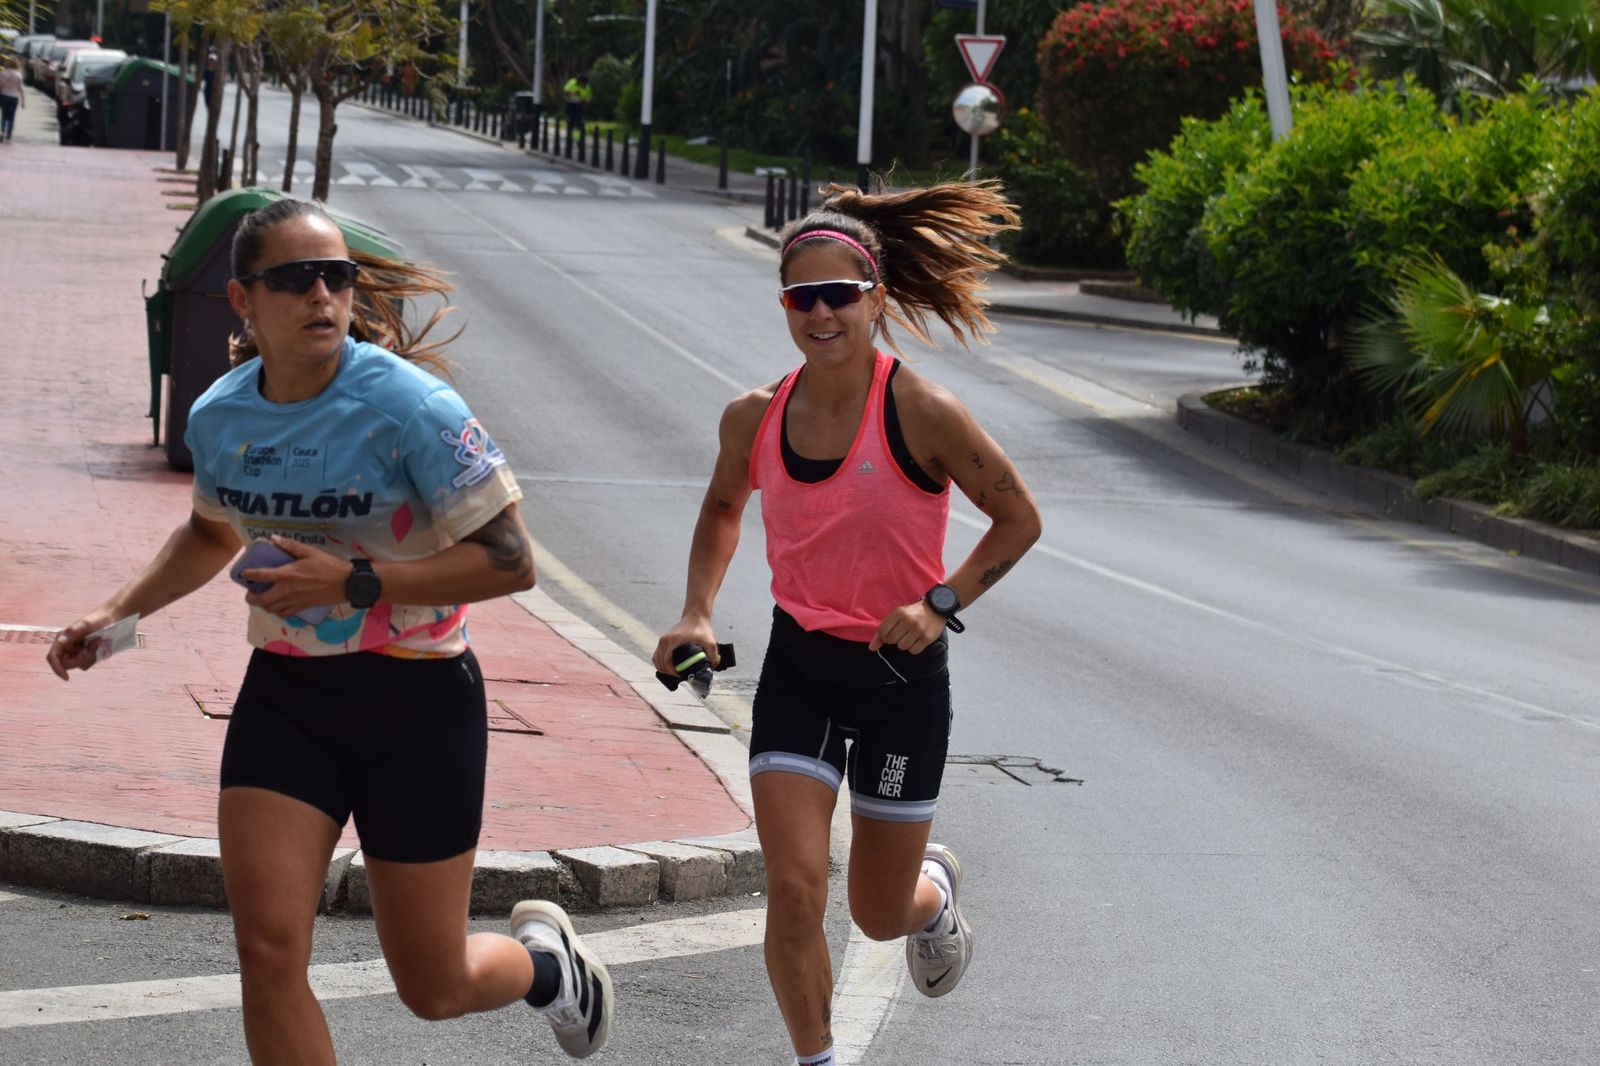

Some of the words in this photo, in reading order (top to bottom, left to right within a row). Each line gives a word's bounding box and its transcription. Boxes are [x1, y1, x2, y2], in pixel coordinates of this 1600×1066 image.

[245, 445, 275, 456] Europe
[243, 465, 262, 478] Cup
[217, 487, 373, 518] TRIATLÓN
[886, 753, 909, 771] THE
[880, 767, 904, 784] COR
[877, 781, 902, 798] NER
